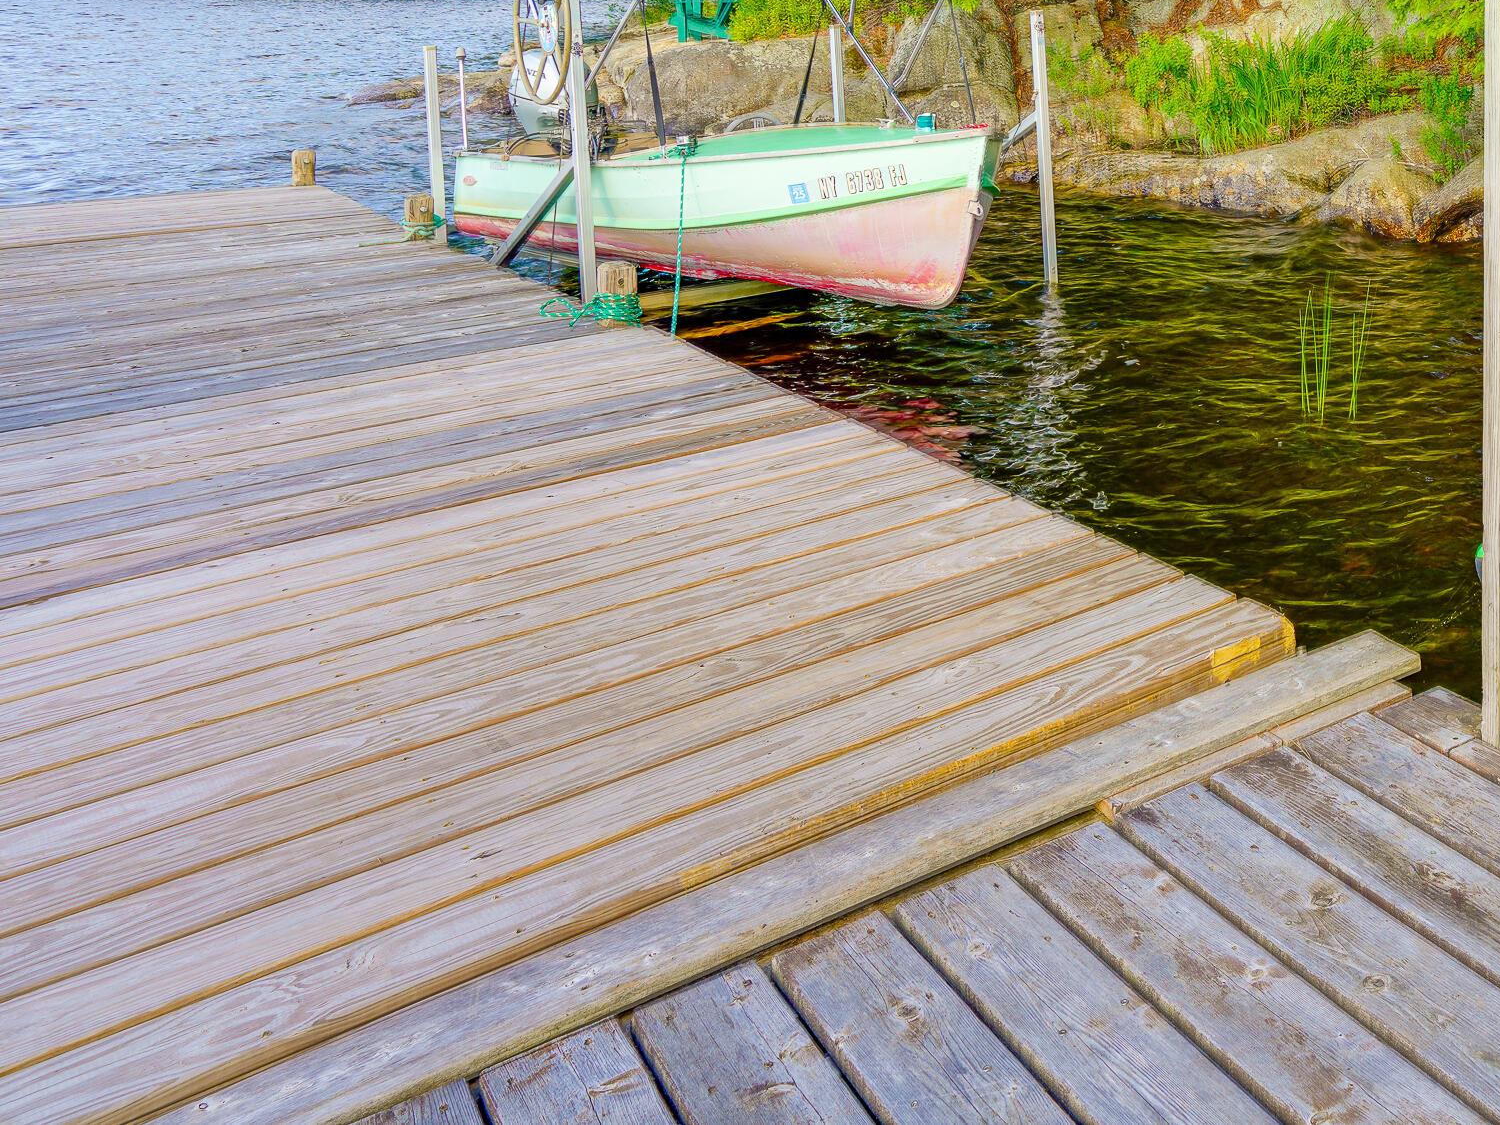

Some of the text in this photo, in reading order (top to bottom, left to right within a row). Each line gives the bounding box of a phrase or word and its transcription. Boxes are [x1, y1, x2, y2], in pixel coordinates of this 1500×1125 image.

[817, 163, 908, 199] NY 6738 FJ
[792, 189, 806, 200] 25
